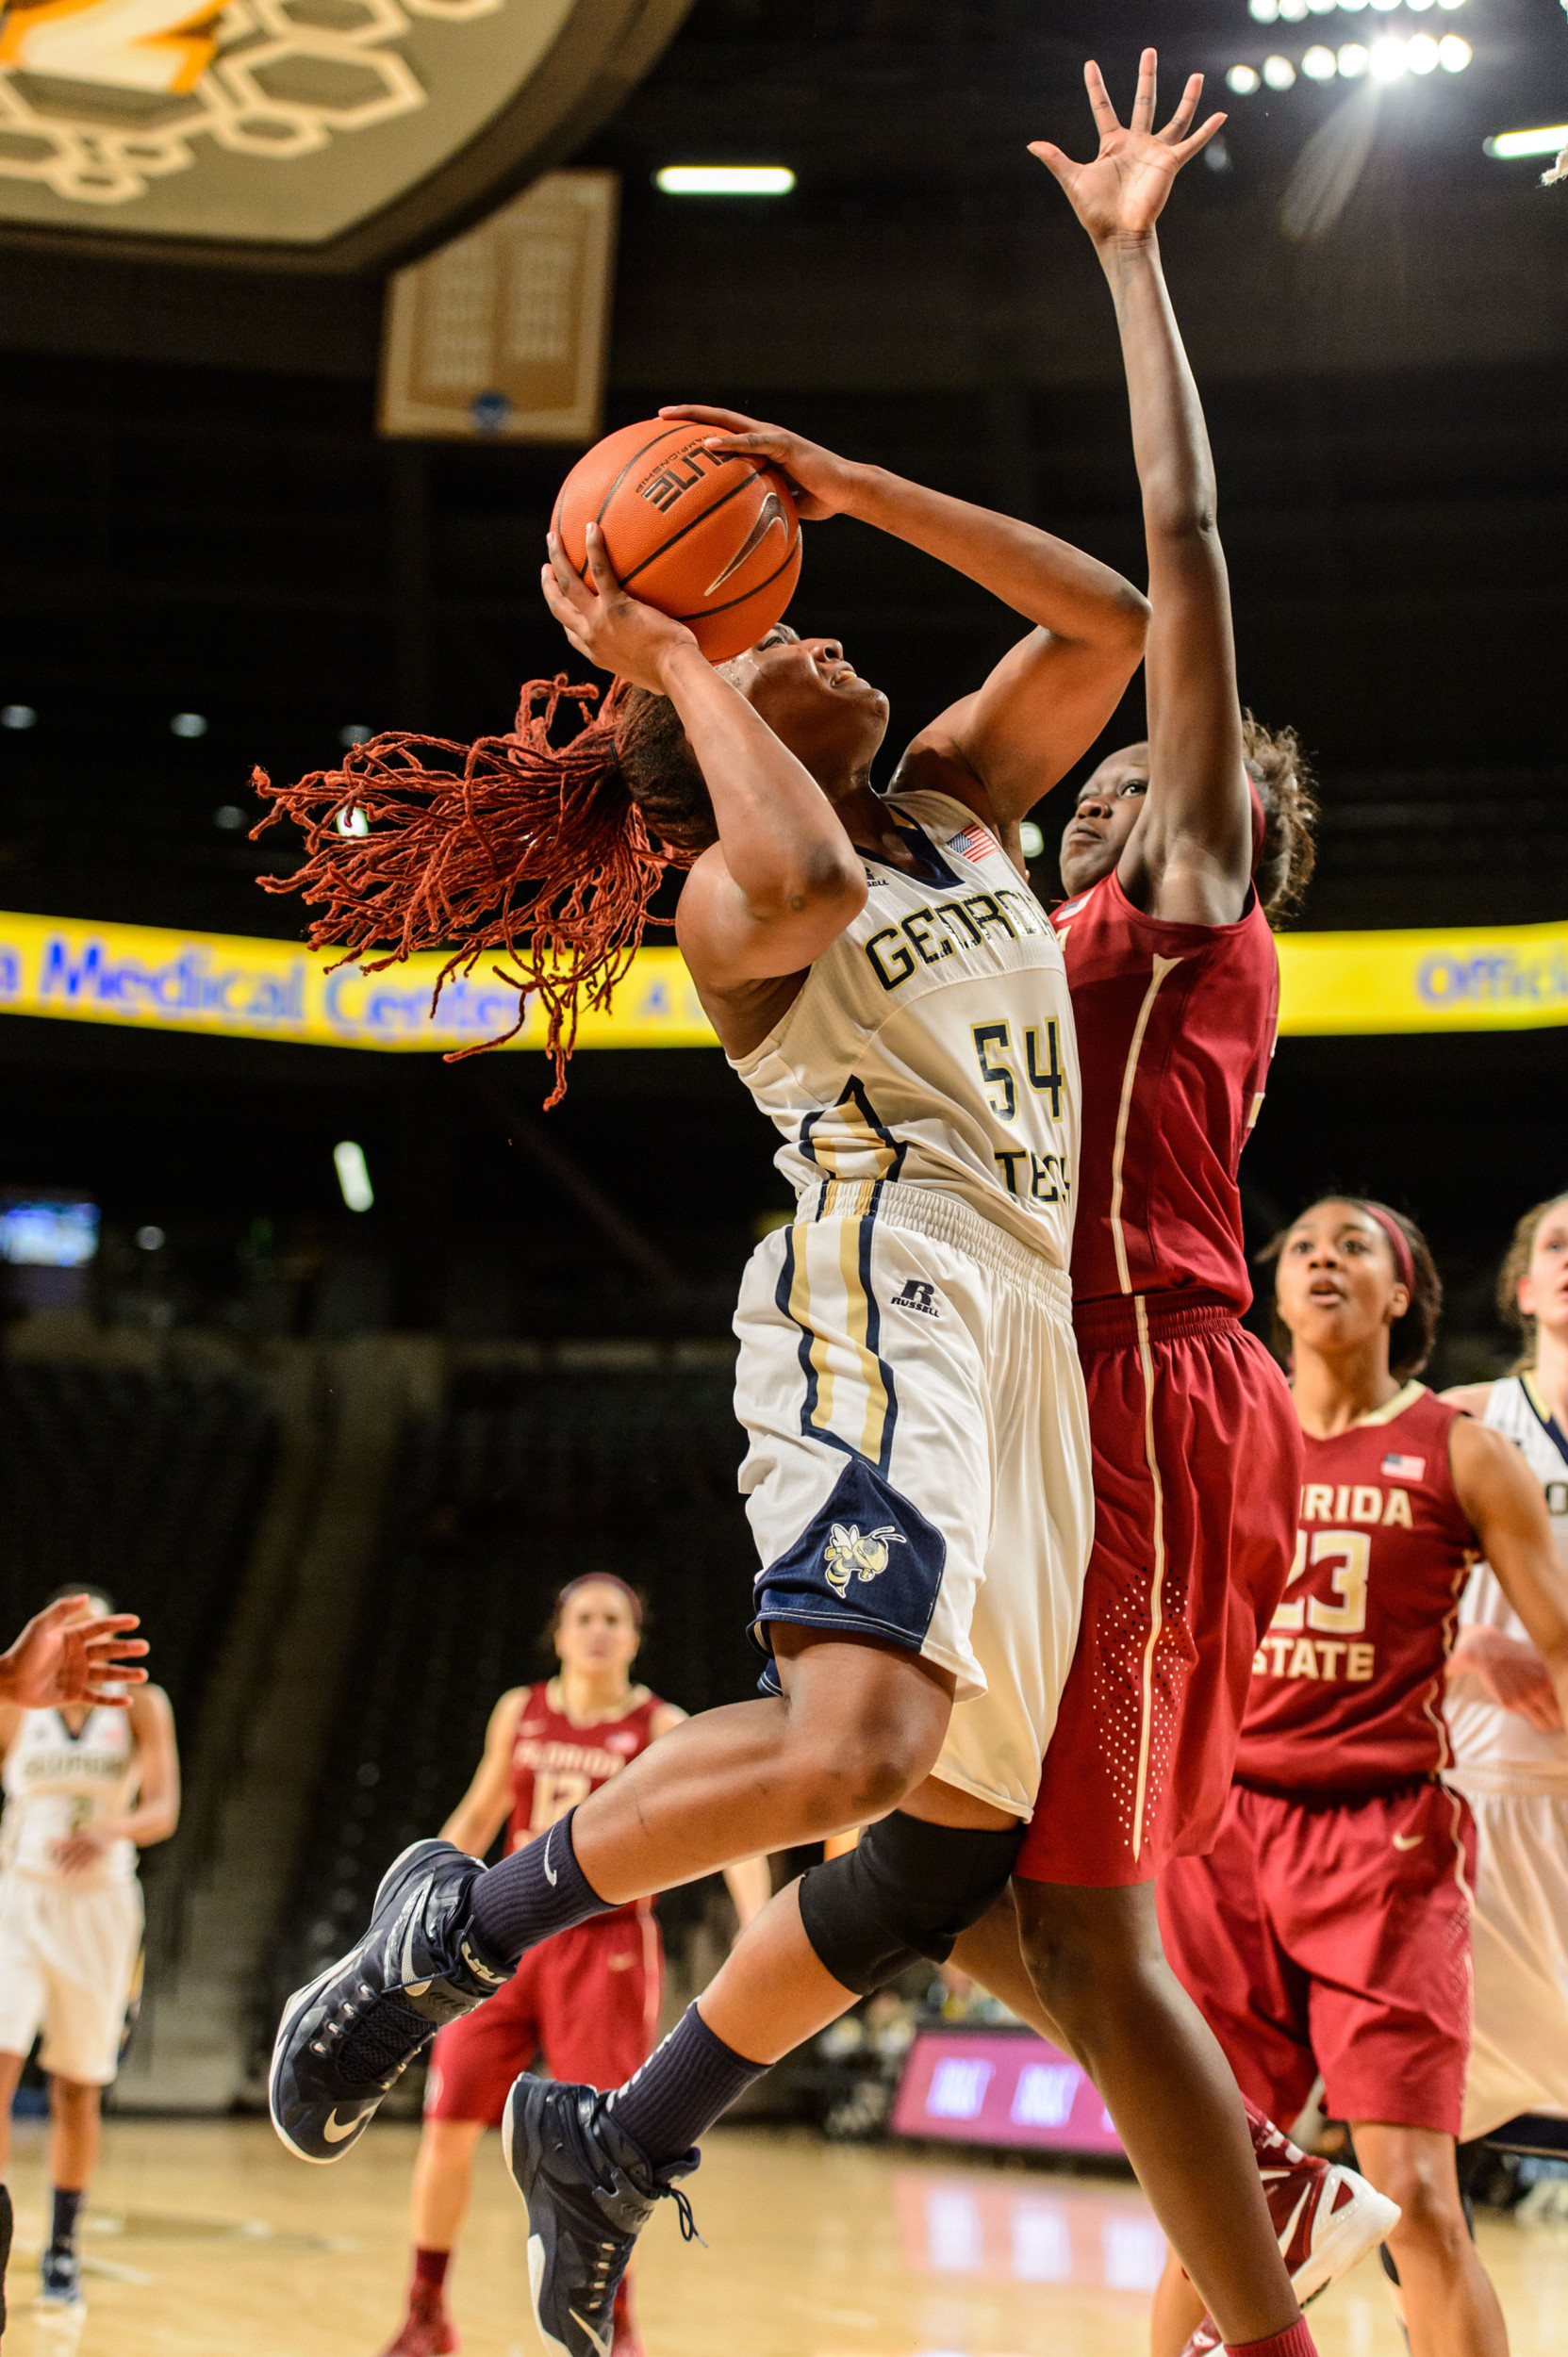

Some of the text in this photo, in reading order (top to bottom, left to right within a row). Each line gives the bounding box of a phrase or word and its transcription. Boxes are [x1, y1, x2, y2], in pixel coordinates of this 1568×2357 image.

[643, 446, 740, 514] LITE
[42, 931, 307, 1030] Medical
[322, 960, 533, 1043] Center
[969, 1015, 1065, 1124] 54
[890, 1296, 940, 1318] RUSSELL
[901, 1279, 934, 1306] R
[1300, 1484, 1413, 1529] RIDA
